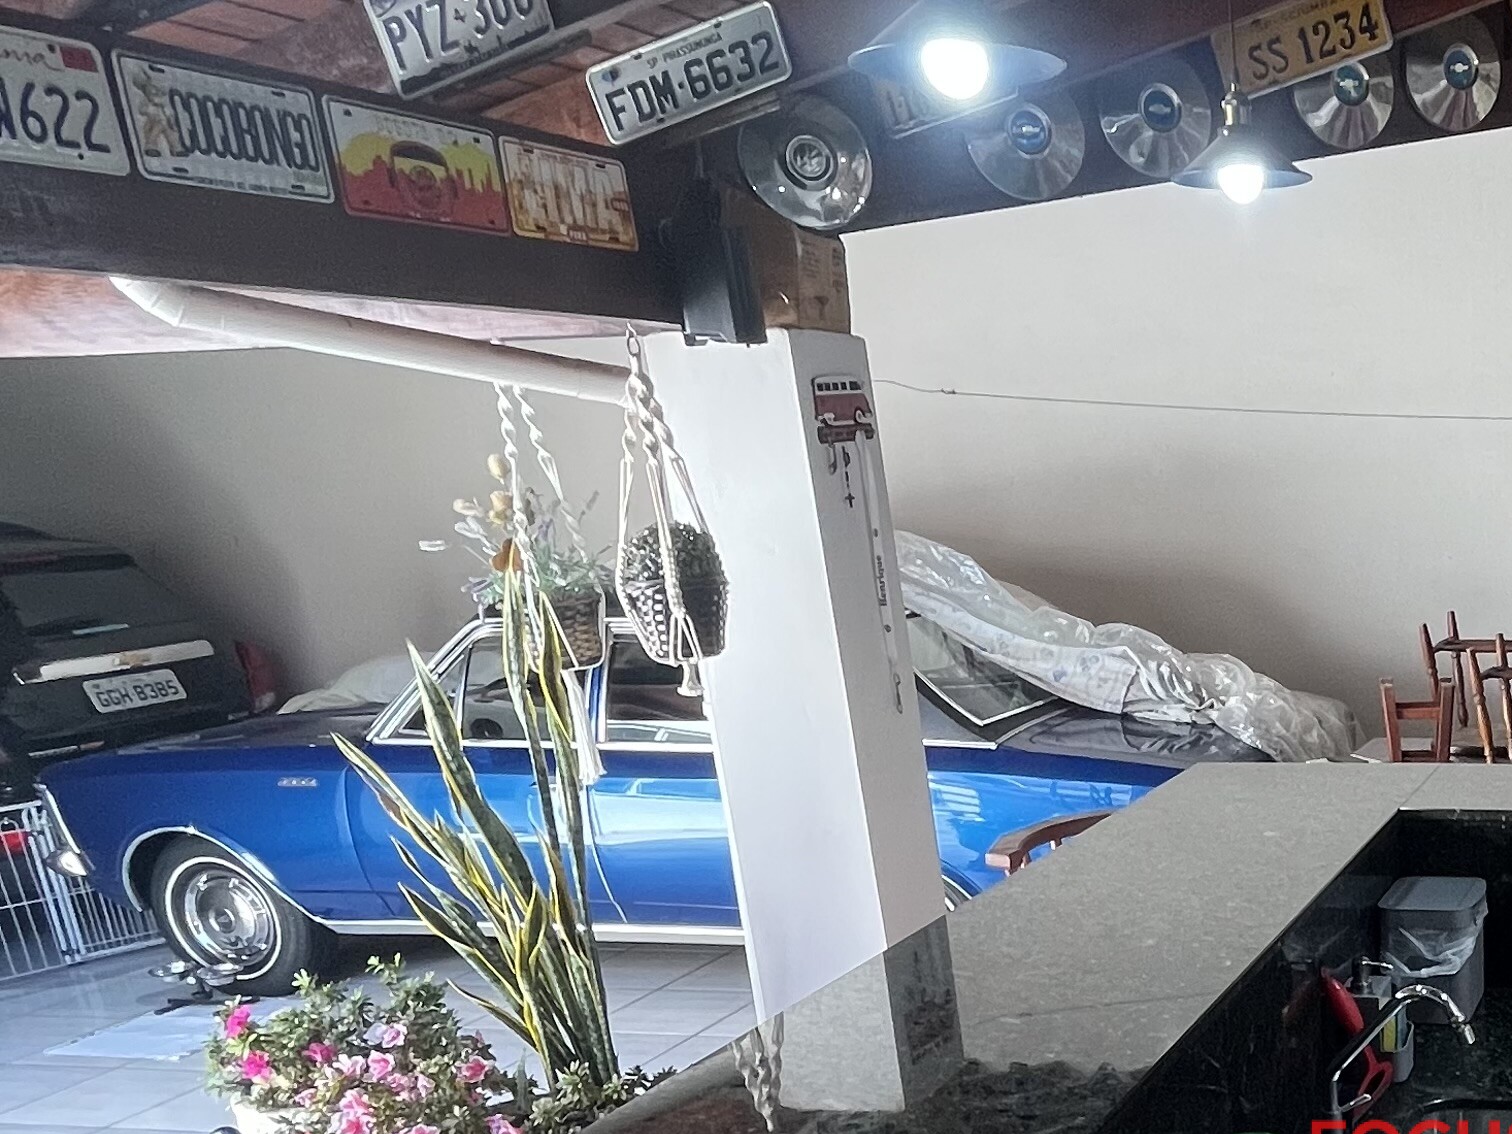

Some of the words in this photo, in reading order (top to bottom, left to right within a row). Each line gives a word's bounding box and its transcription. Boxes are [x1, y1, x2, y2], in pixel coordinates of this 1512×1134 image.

[383, 0, 461, 71] PYZ
[1248, 36, 1289, 81] SS
[1298, 2, 1379, 65] 1234
[168, 88, 320, 172] COCOBONGO
